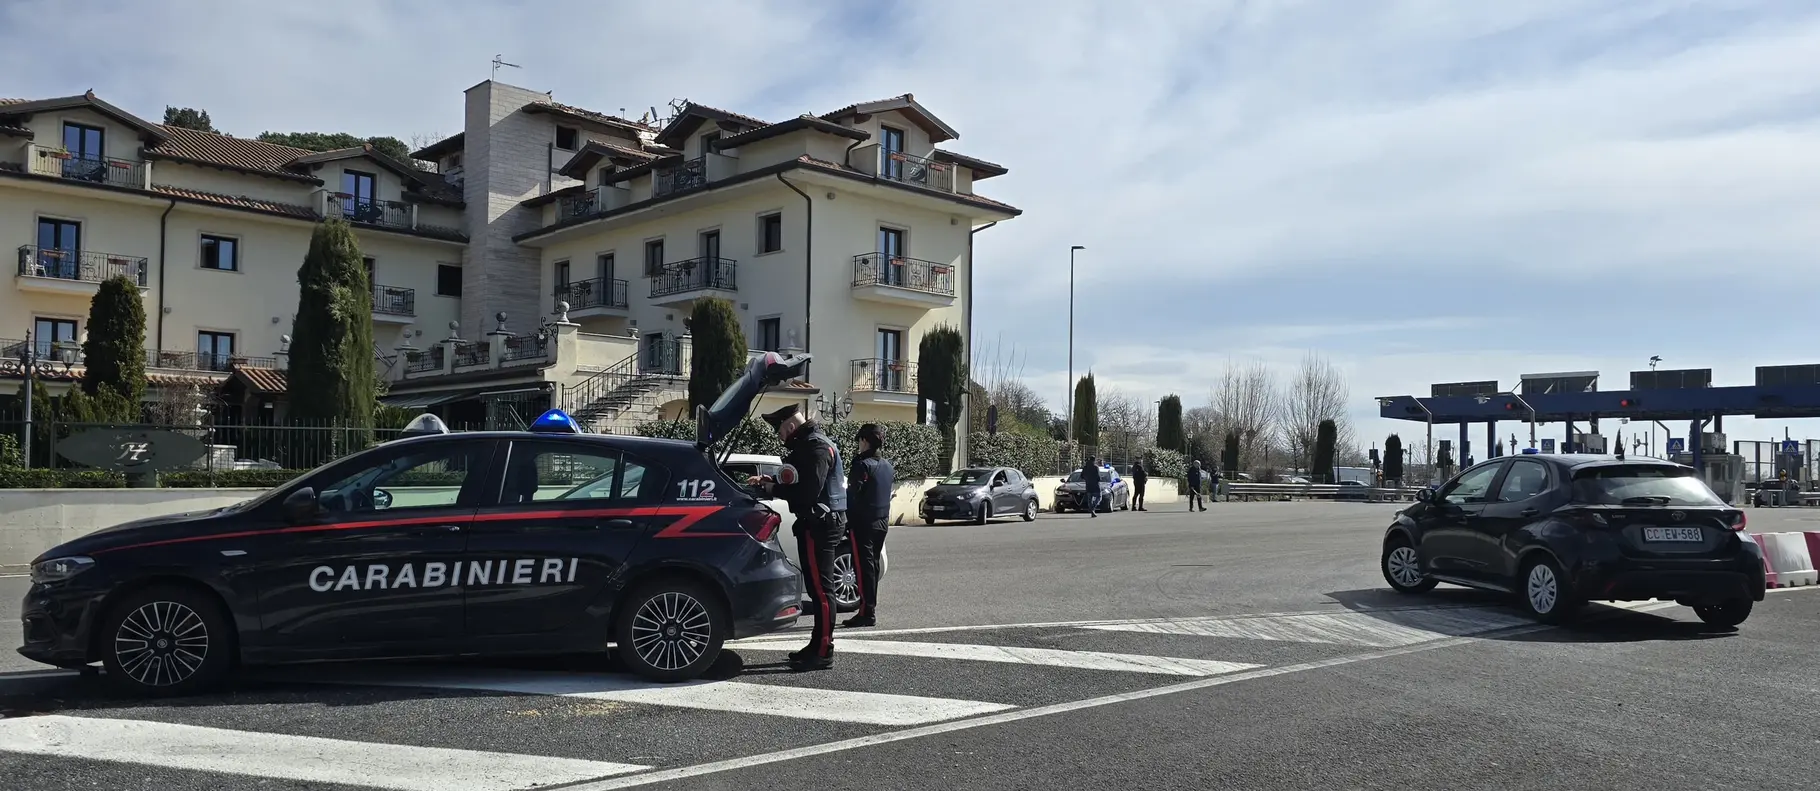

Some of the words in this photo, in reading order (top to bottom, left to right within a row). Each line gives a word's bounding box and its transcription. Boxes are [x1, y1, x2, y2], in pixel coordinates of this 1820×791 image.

[677, 479, 716, 498] 112
[1646, 529, 1660, 540] CC
[309, 557, 579, 592] CARABINIERI
